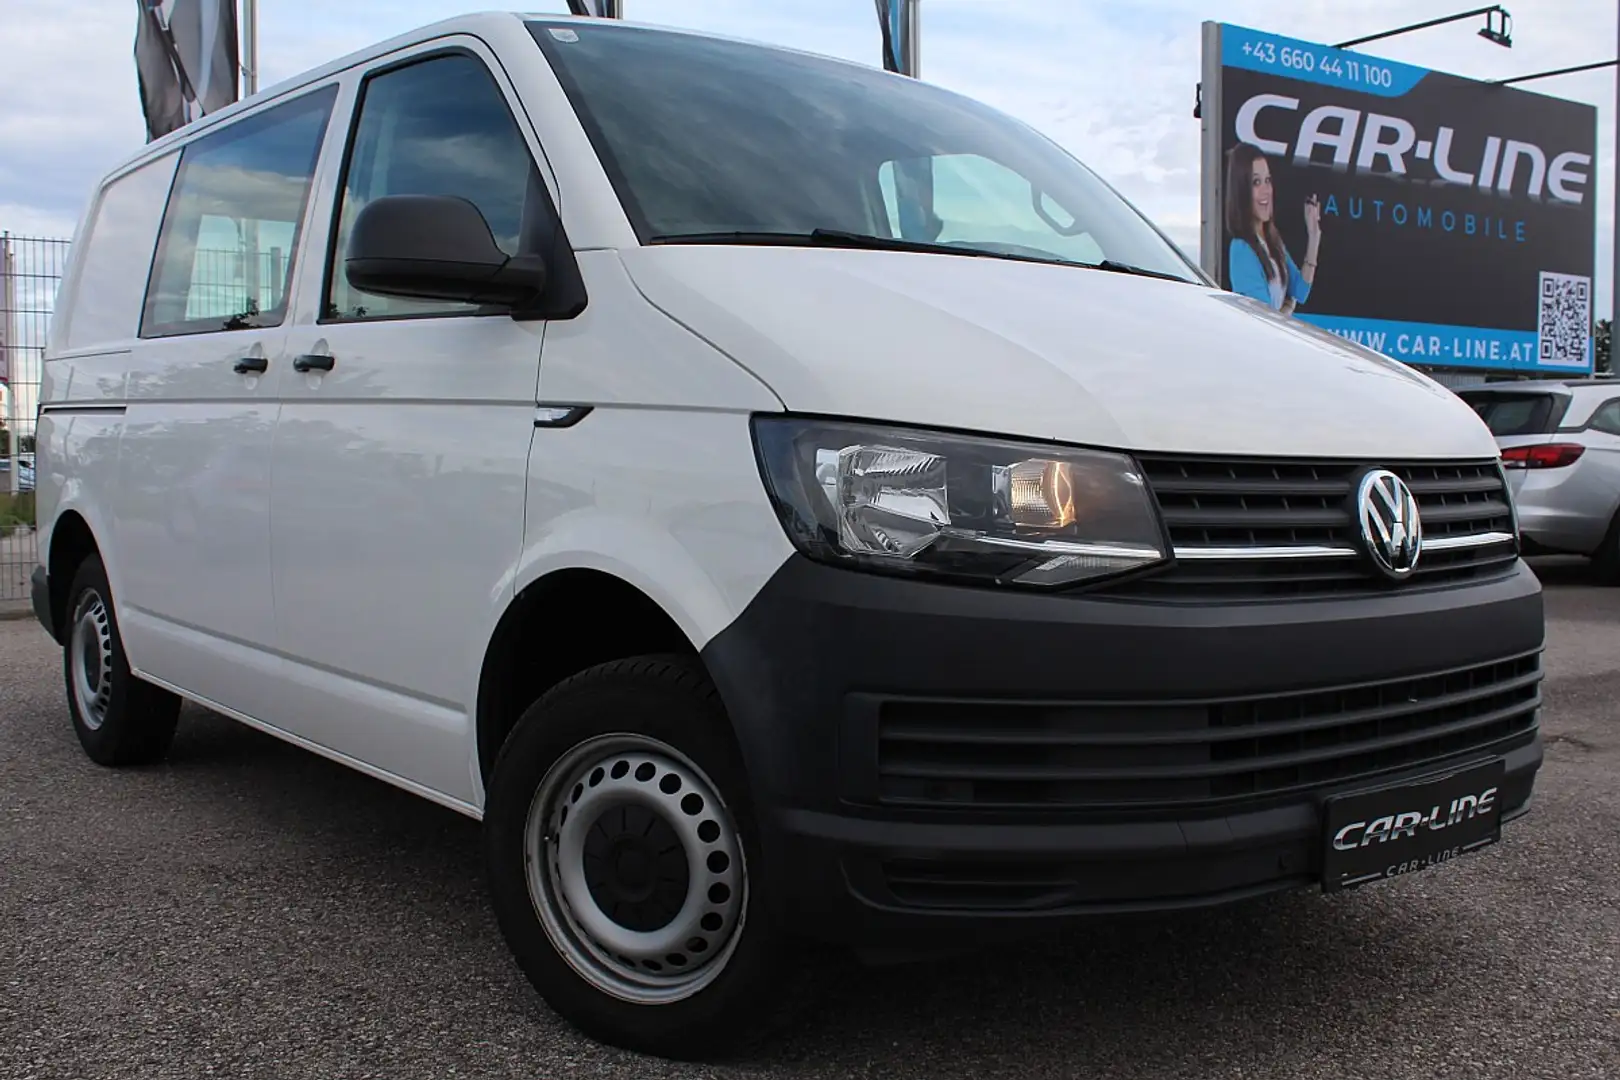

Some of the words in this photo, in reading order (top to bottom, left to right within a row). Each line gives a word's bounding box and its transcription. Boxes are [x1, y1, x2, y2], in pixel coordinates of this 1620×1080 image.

[1242, 41, 1276, 64] +43
[1280, 47, 1315, 72] 660
[1319, 55, 1343, 78] 44
[1346, 60, 1359, 82] 11
[1363, 64, 1392, 88] 100
[1324, 194, 1525, 242] AUTOMOBILE
[1327, 328, 1534, 362] WW.CAR-LINE.AT
